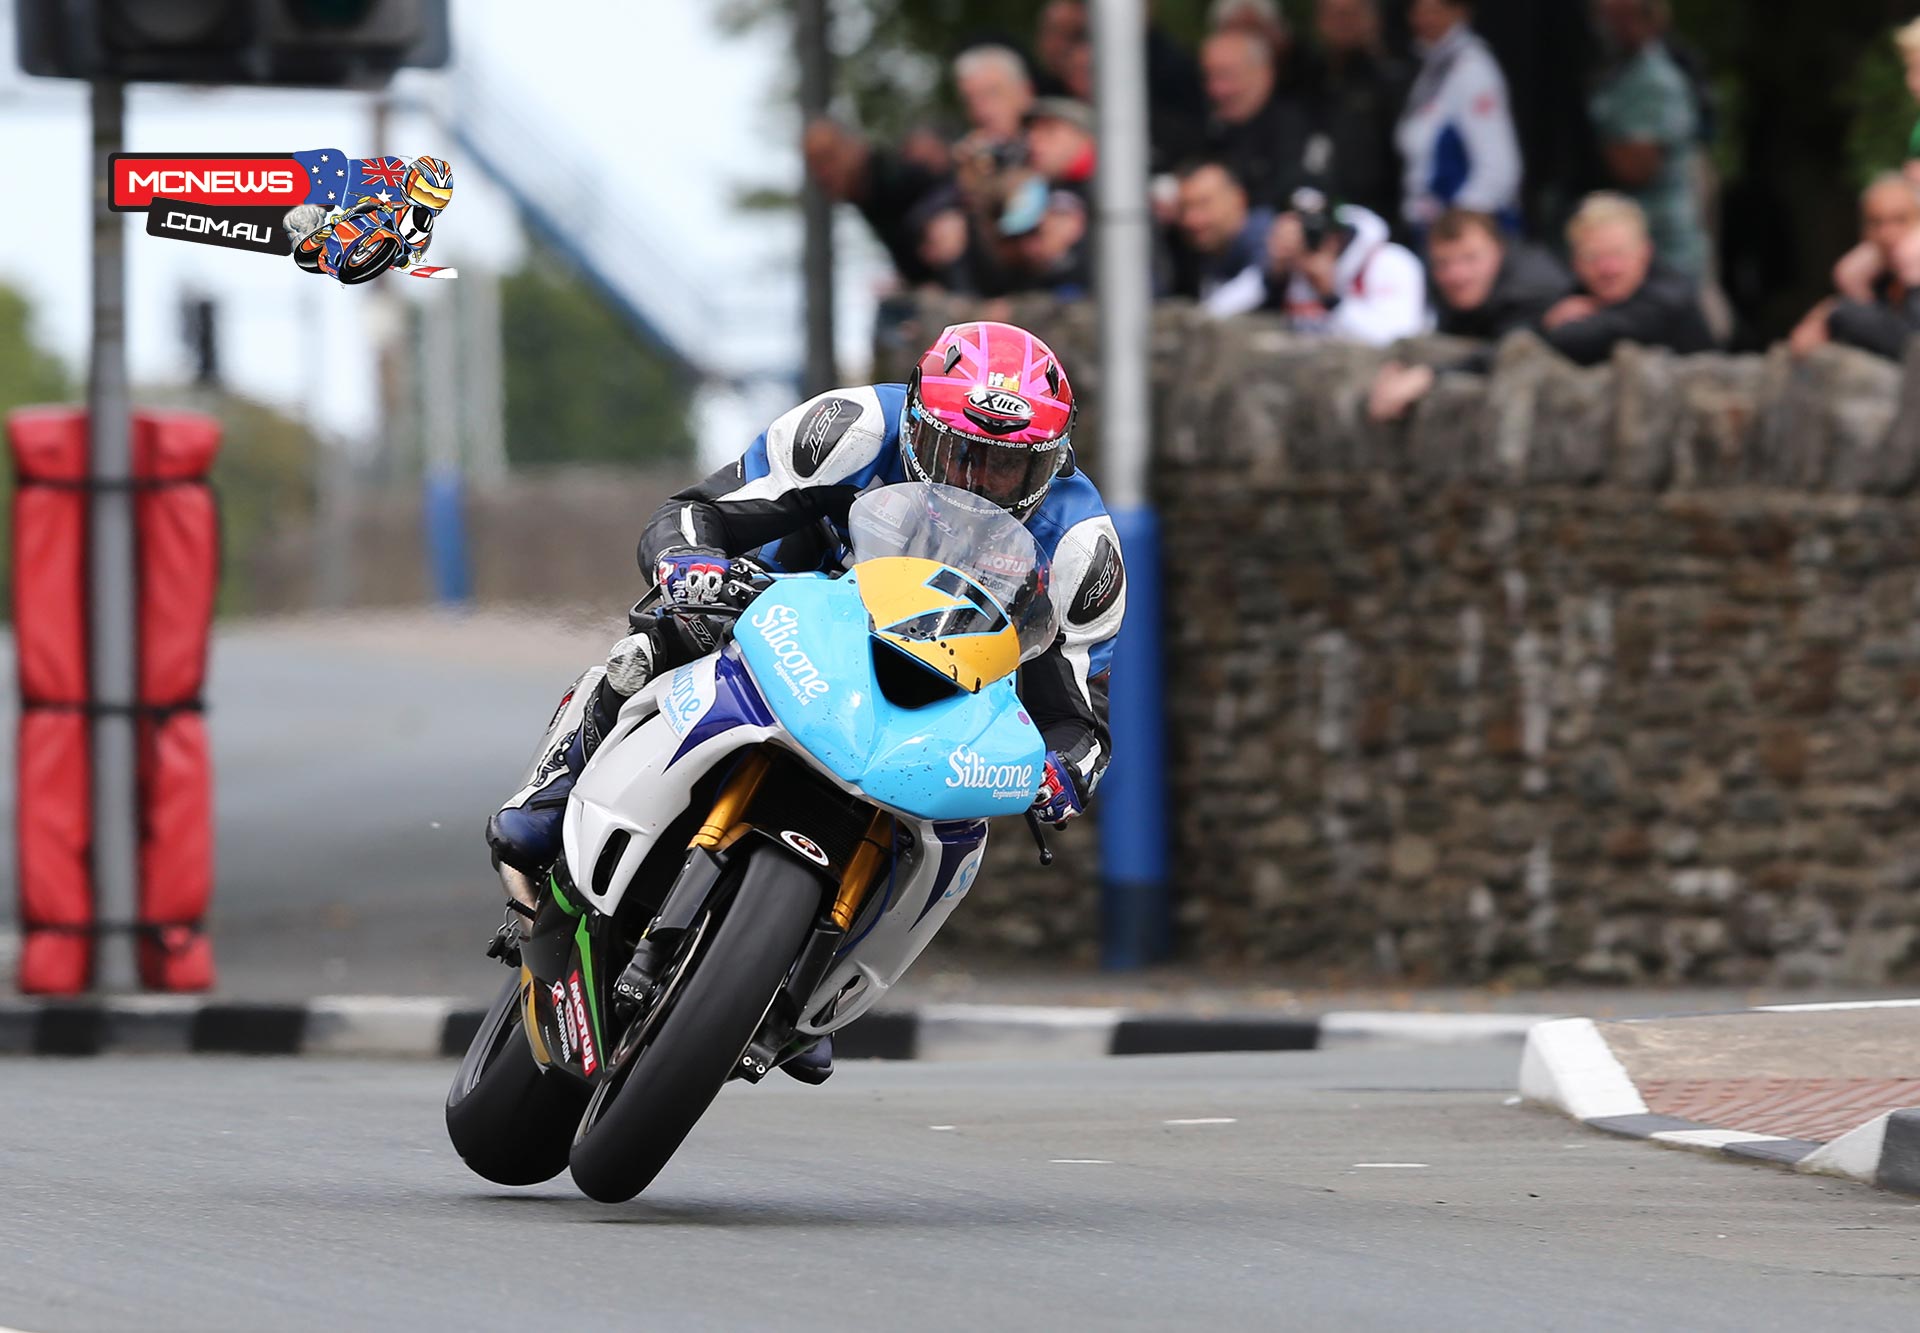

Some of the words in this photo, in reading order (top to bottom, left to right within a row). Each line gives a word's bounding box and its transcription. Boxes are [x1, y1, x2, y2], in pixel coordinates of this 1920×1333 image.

[975, 391, 1024, 413] X-lite
[809, 399, 842, 466] RST
[688, 616, 718, 648] ST
[751, 604, 830, 699] Silicone
[945, 743, 1032, 788] Silicone
[570, 981, 595, 1071] MOTUL
